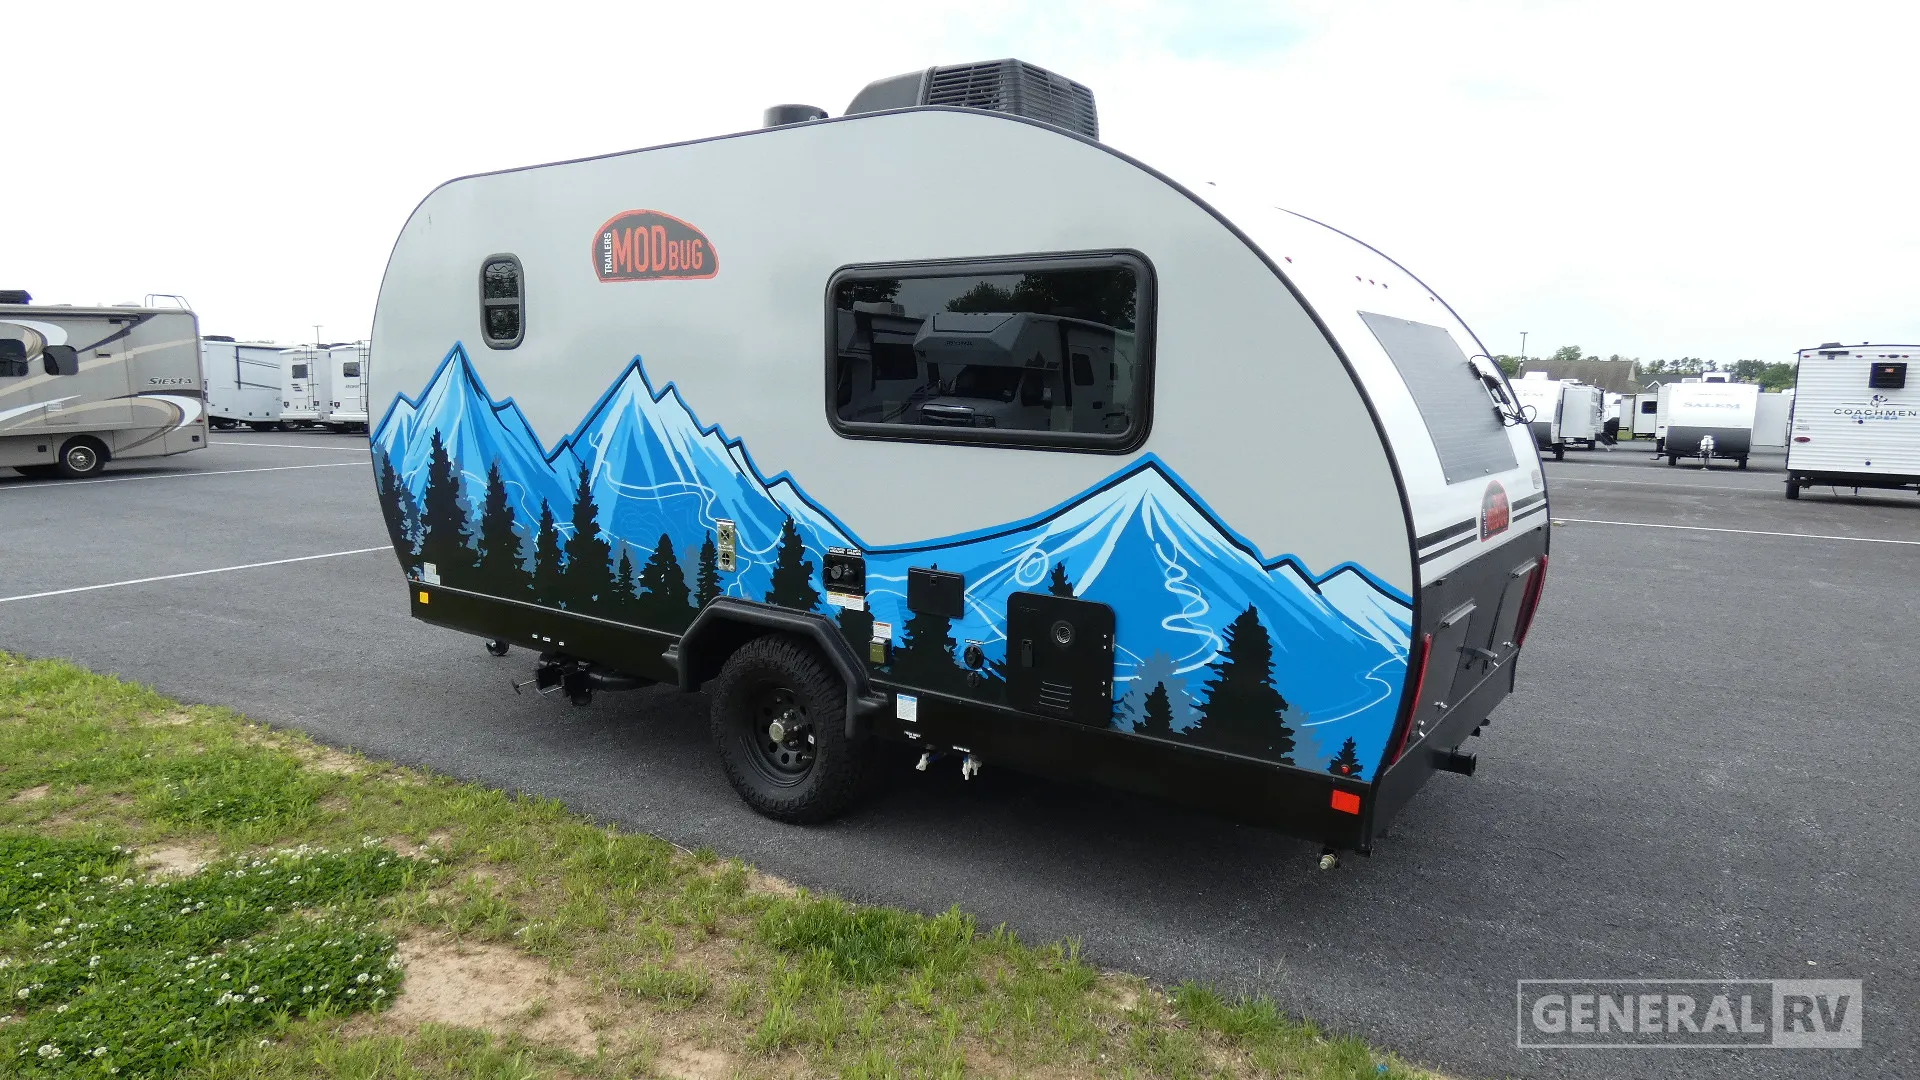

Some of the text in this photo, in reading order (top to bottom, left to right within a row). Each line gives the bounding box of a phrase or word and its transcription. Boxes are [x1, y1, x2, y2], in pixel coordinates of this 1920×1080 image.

[603, 232, 612, 275] TRAILERS
[1683, 401, 1741, 409] SALEM
[1833, 408, 1917, 416] COACHMEN
